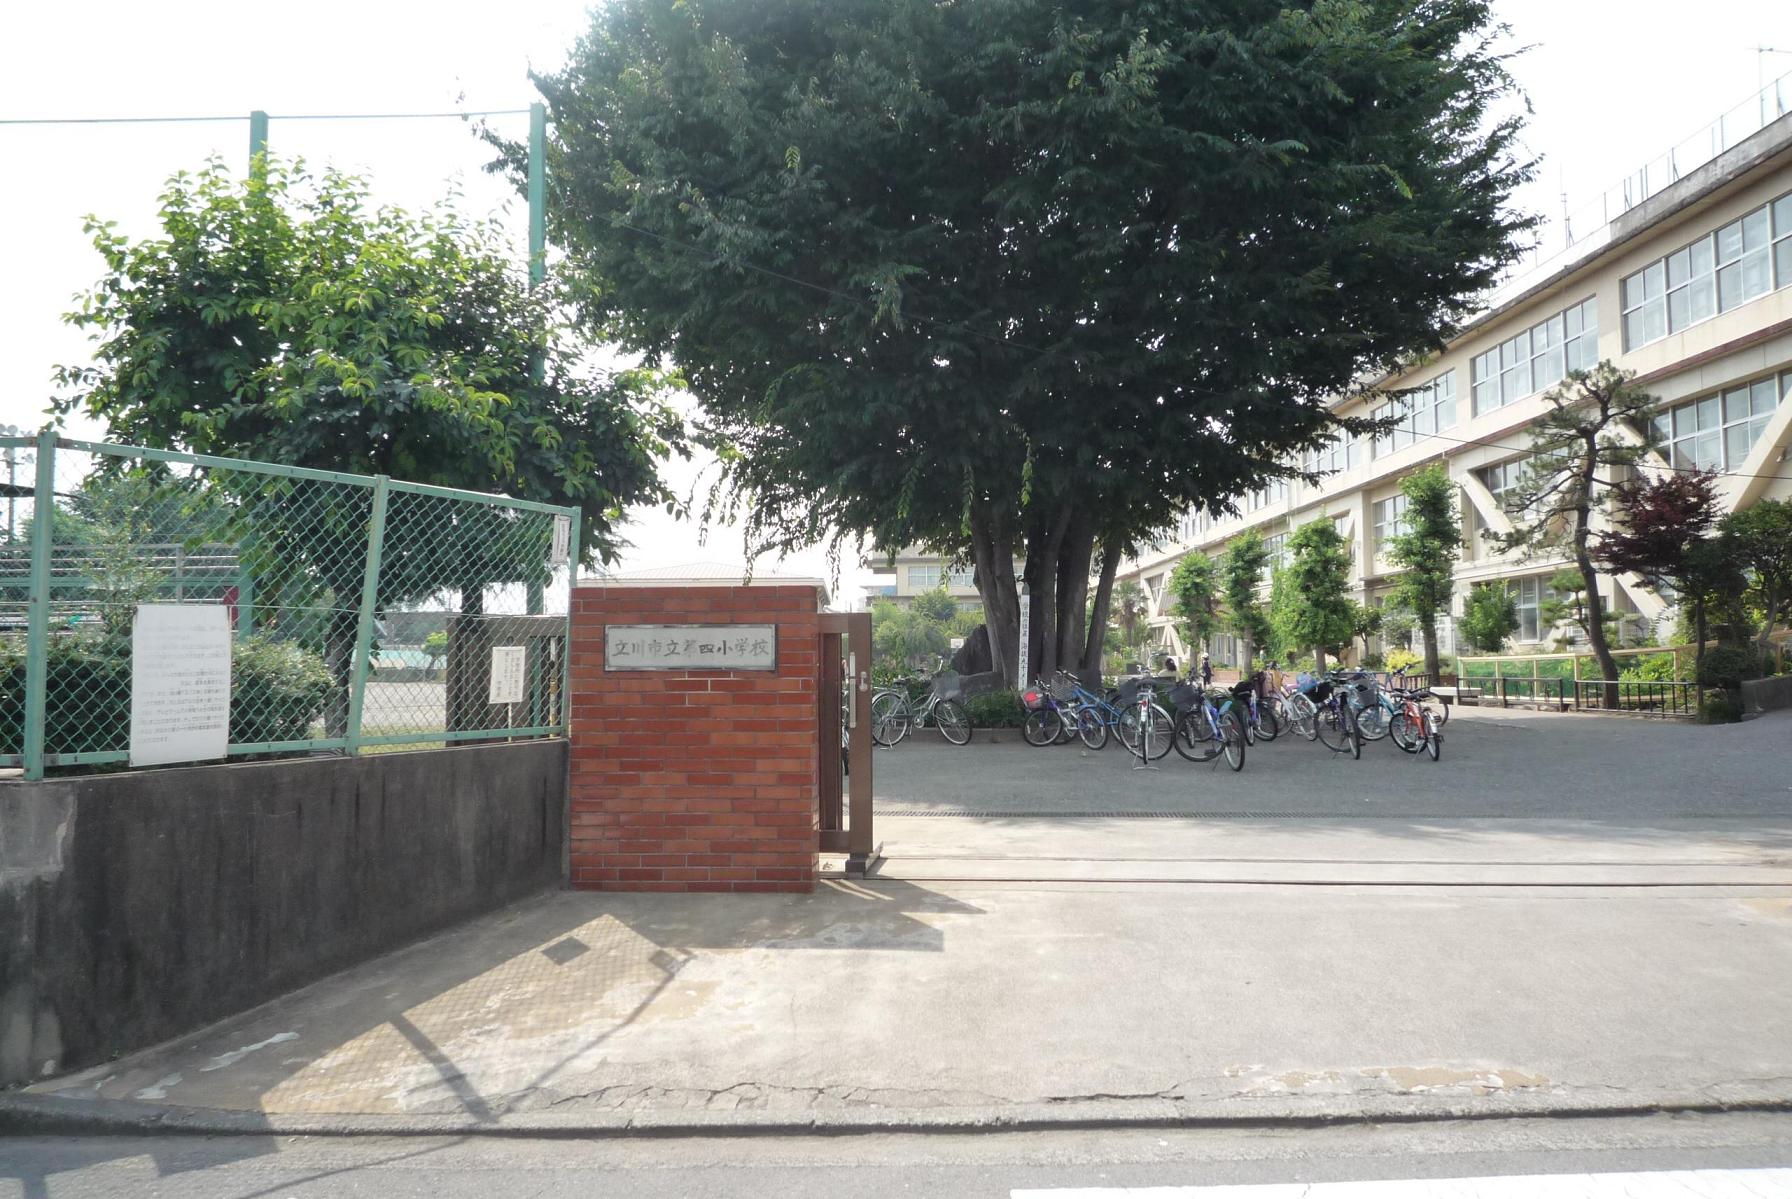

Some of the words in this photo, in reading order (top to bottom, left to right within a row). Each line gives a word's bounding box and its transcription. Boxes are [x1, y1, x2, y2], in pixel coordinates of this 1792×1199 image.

[611, 637, 770, 659] 立川市立第四小学校
